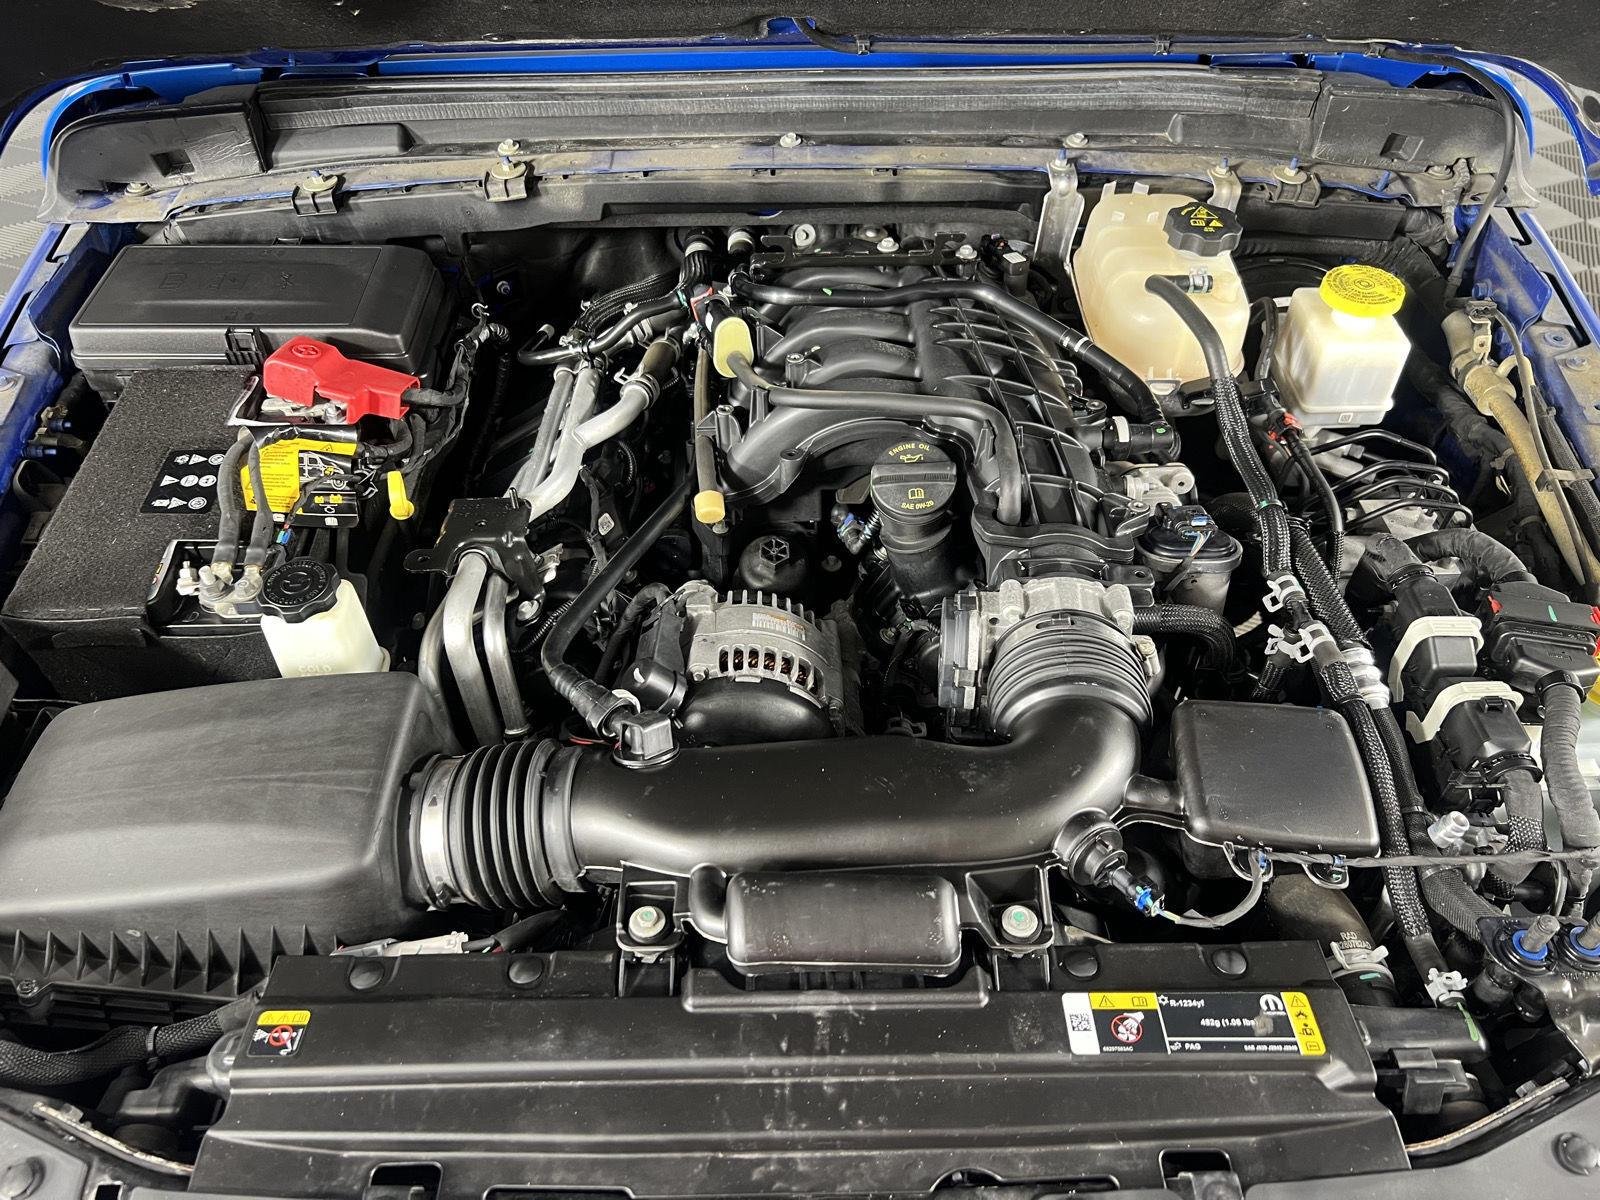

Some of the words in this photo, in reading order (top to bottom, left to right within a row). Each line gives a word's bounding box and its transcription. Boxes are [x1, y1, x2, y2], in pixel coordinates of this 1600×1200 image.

[888, 442, 916, 456] ENGINE
[918, 443, 930, 452] OIL
[901, 501, 915, 510] SAE
[915, 500, 935, 510] 0W-20
[1340, 931, 1358, 940] RAD
[1184, 1043, 1202, 1051] PAG
